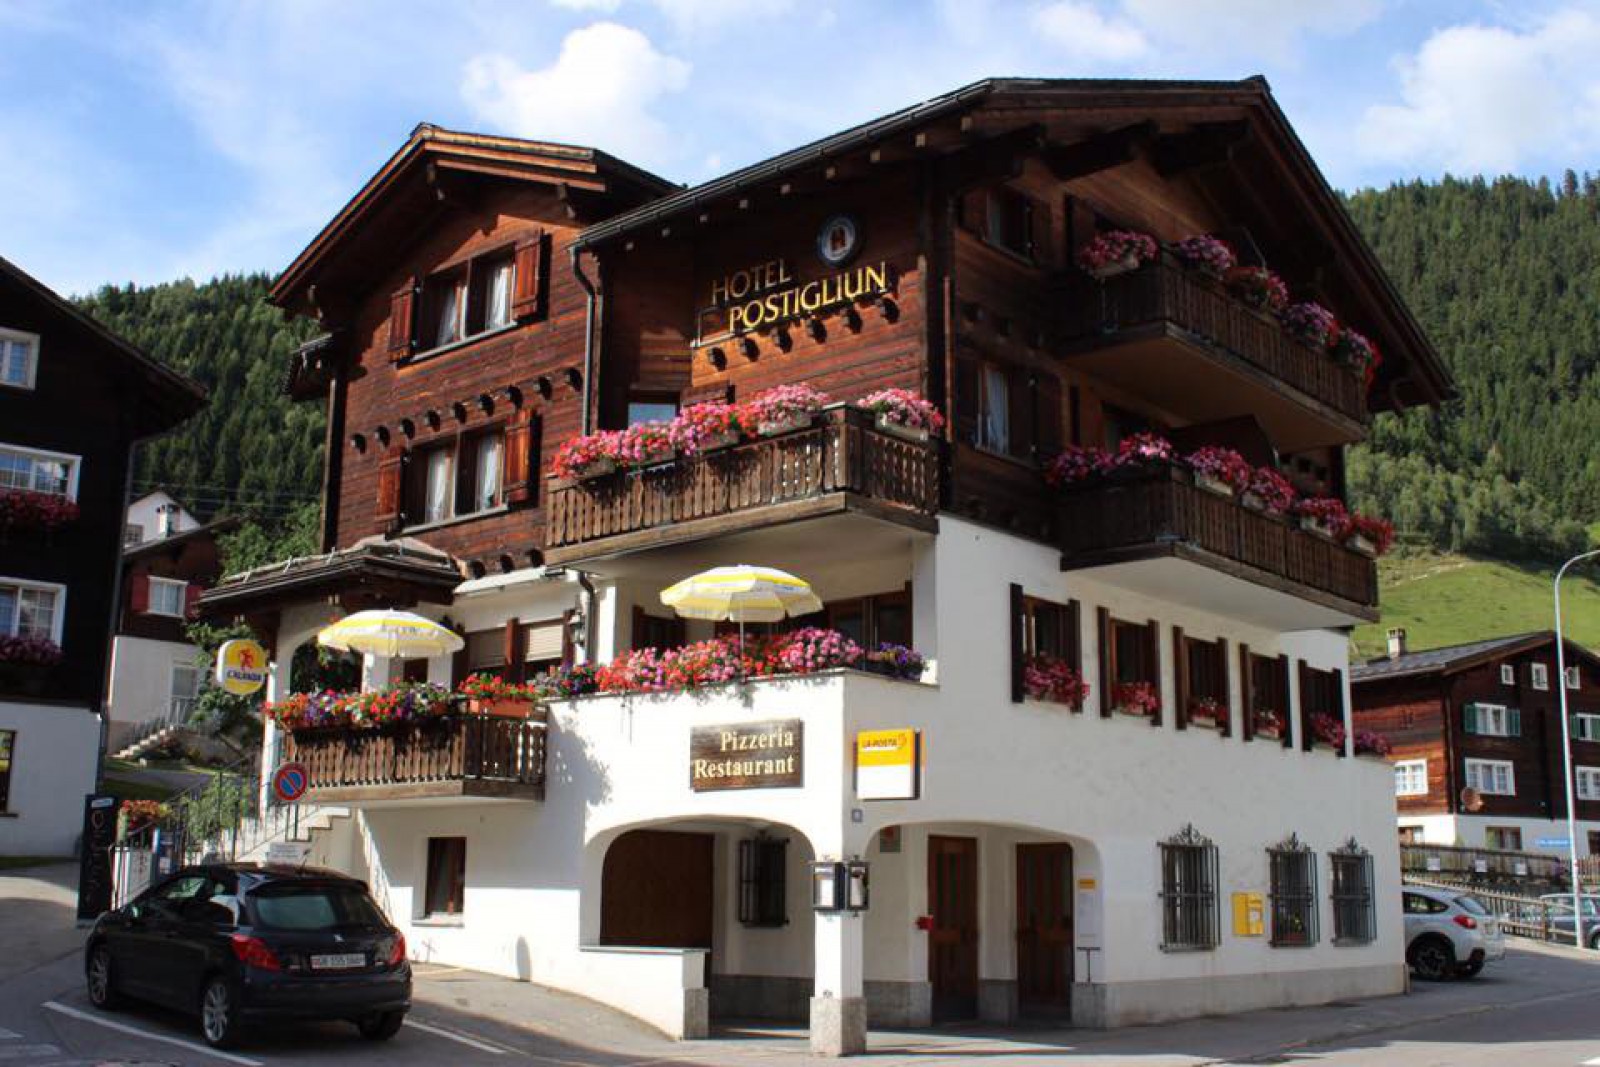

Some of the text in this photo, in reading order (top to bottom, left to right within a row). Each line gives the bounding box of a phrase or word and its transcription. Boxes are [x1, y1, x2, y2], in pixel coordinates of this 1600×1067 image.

[712, 258, 793, 305] HOTEL
[729, 261, 887, 333] POSTIGLIUN
[720, 725, 794, 752] Pizzeria
[693, 754, 795, 779] Restaurant
